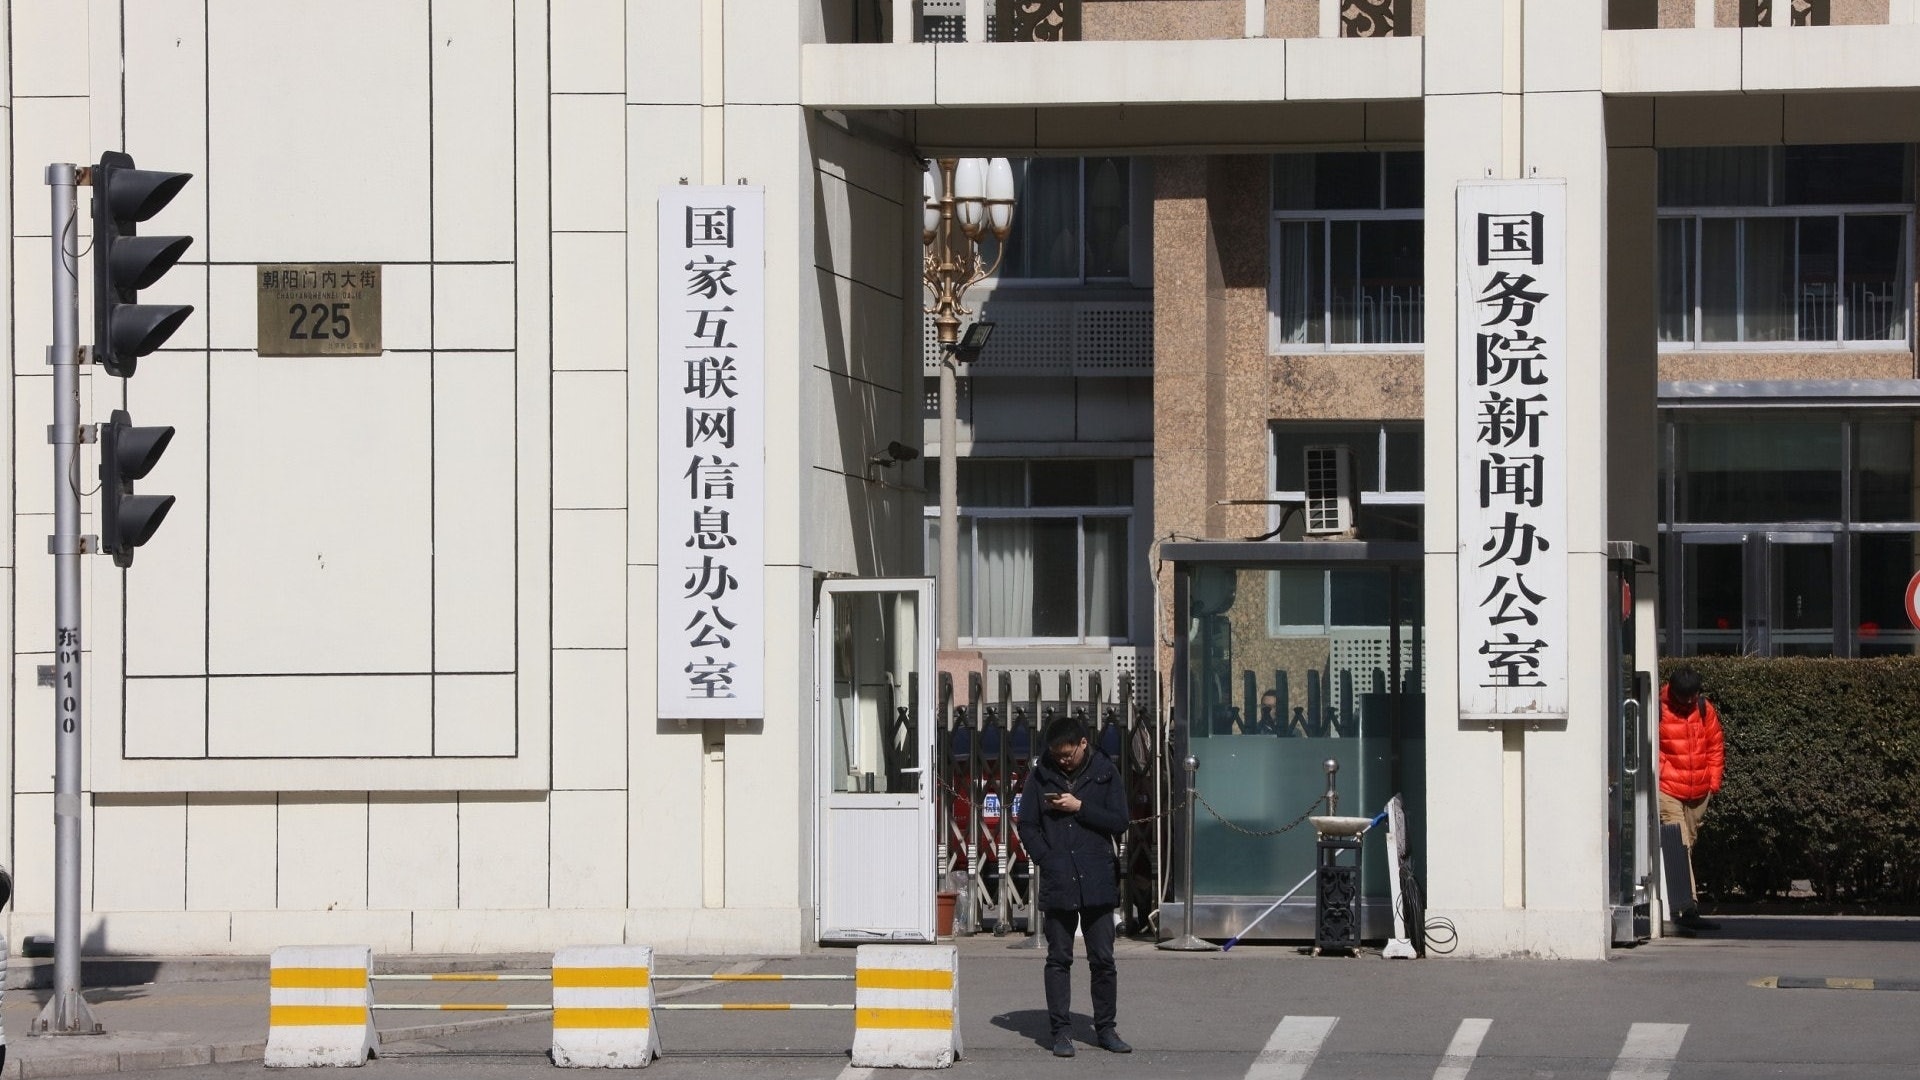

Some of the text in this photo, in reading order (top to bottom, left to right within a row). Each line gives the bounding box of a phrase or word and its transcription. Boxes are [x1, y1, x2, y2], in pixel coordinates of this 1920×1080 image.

[262, 270, 376, 289] 朝阳门内大街
[289, 303, 351, 340] 225
[683, 204, 739, 699] 国家互联网信息办公室
[1475, 210, 1550, 688] 国务院新闻办公室
